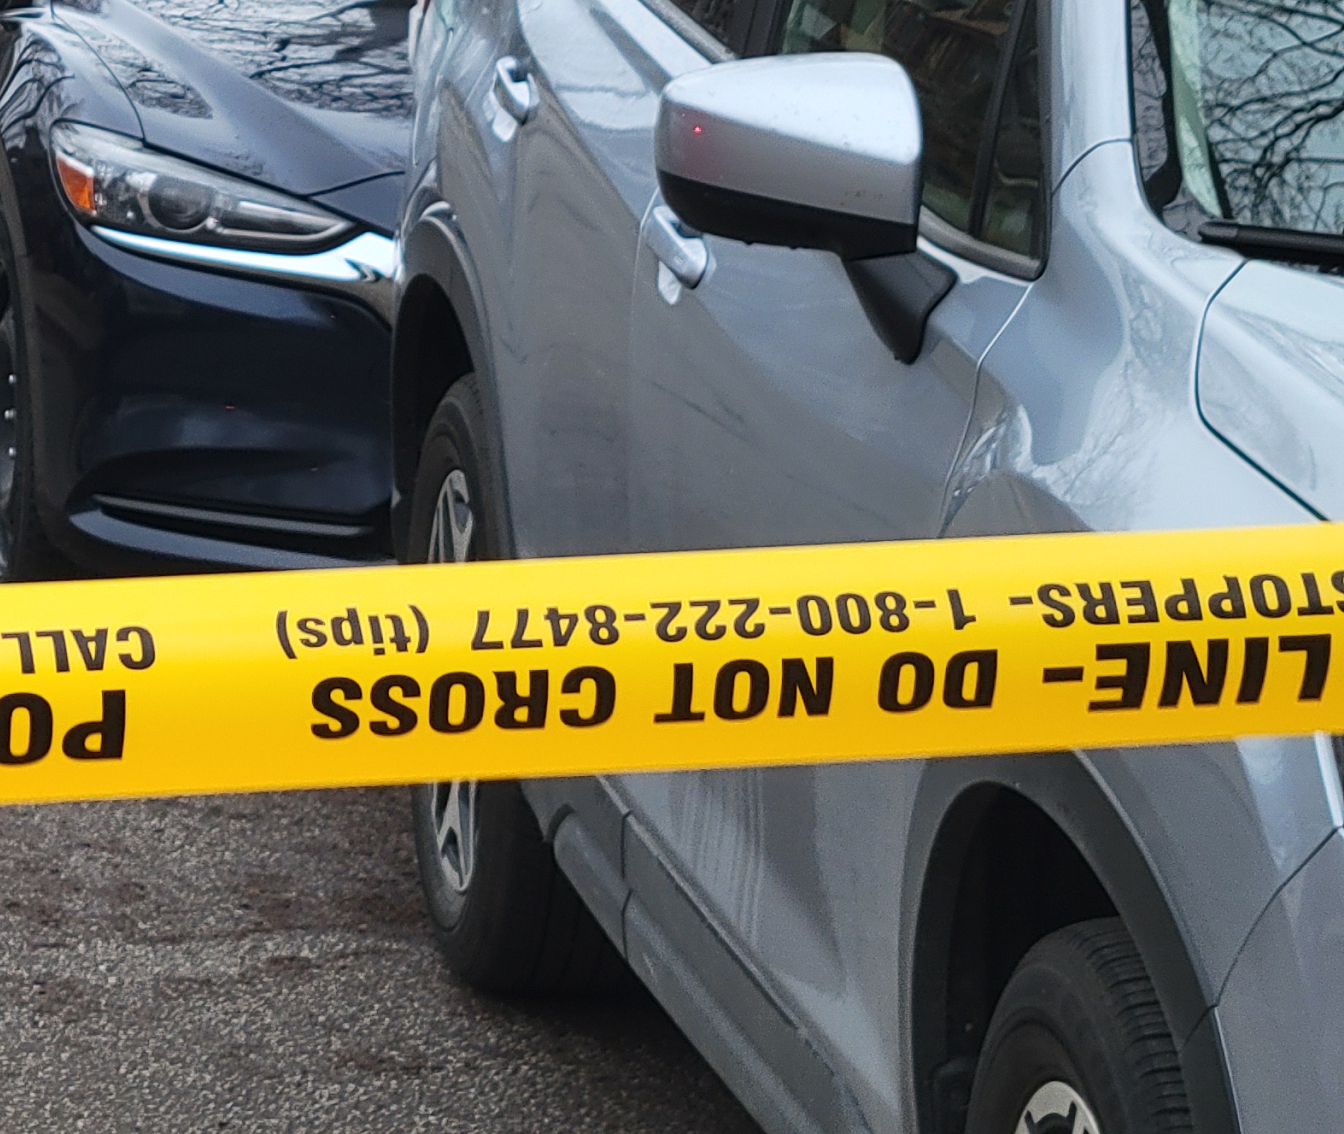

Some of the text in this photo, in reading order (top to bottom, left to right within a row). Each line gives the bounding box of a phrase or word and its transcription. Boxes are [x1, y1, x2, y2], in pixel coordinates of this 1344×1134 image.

[2, 626, 156, 674] CALL
[277, 606, 429, 659] (tips)
[471, 588, 978, 651] 1-800-222-8477
[311, 666, 616, 739] CROSS
[654, 656, 834, 723] NOT
[878, 649, 998, 713] DO
